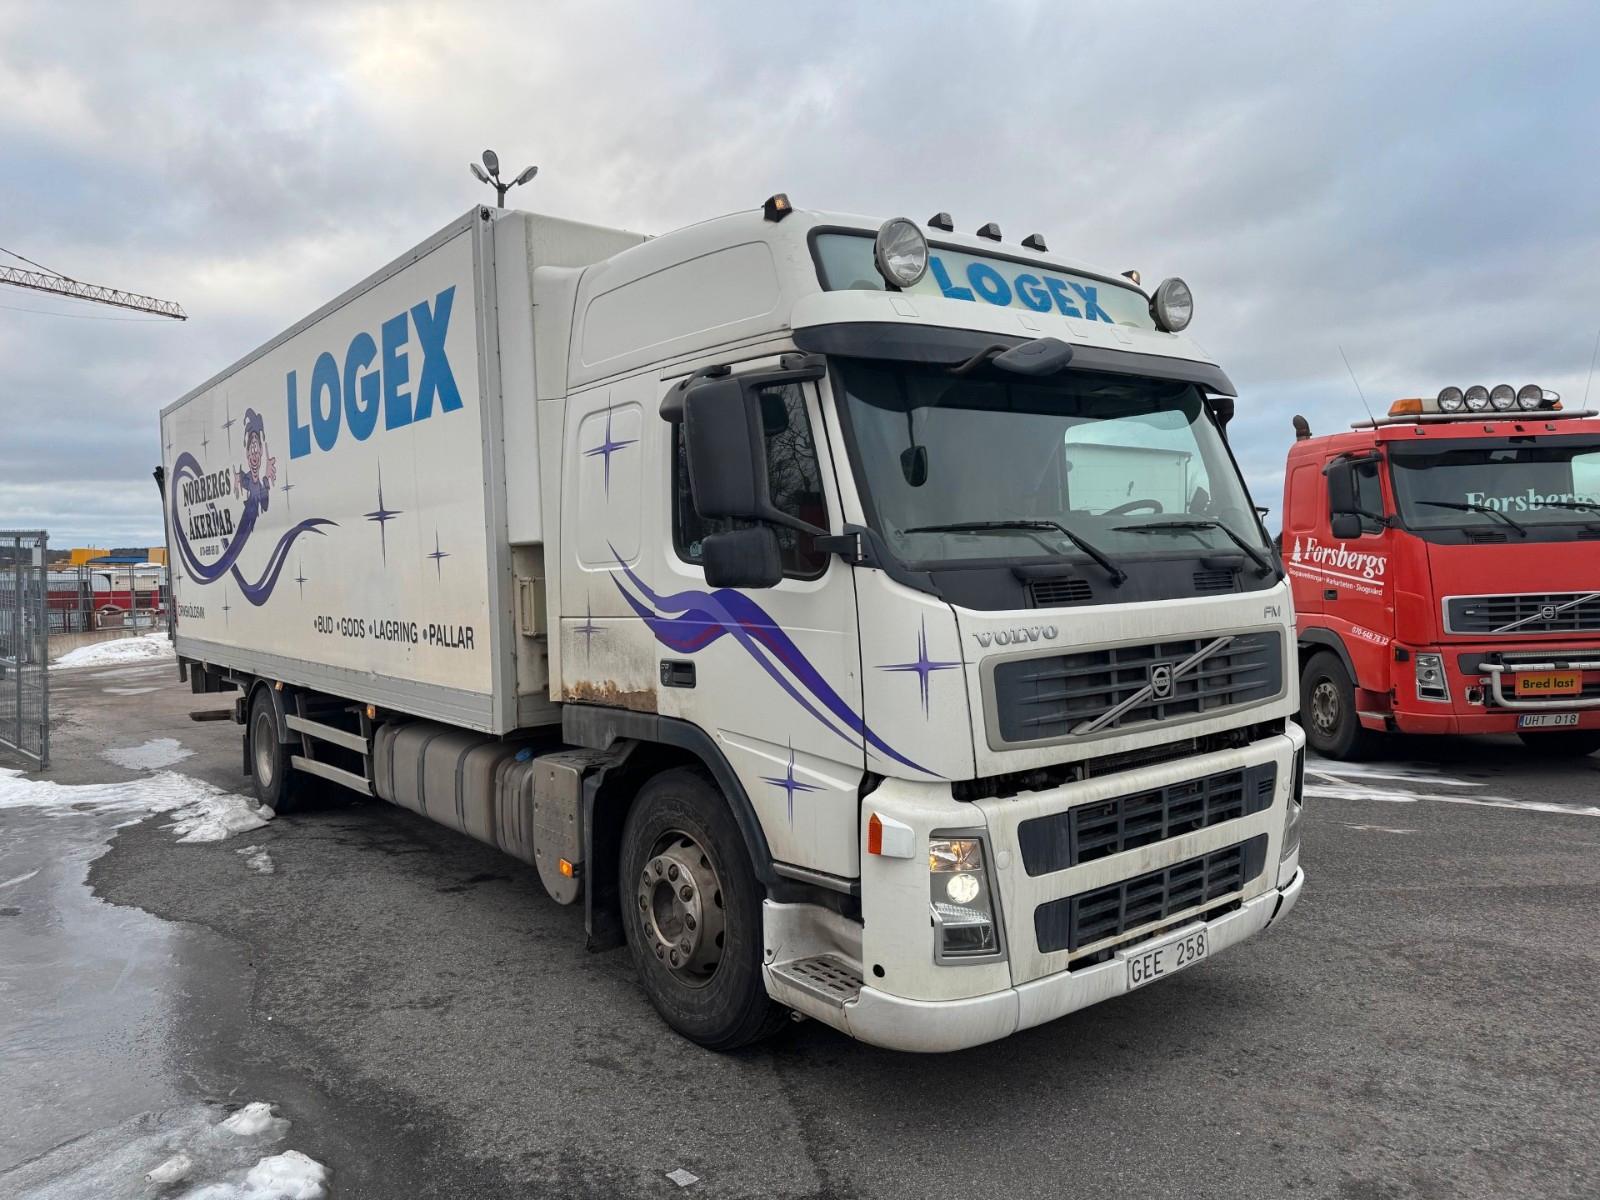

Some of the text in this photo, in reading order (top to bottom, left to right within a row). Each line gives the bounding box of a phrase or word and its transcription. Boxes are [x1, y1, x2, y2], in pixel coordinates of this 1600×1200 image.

[928, 255, 1115, 324] LOGEX
[287, 284, 464, 460] LOGEX
[182, 468, 231, 507] NORBERGS
[1465, 488, 1600, 514] Forsberg
[219, 508, 233, 536] AB
[1304, 537, 1387, 578] Forsbergs
[1263, 605, 1281, 618] FM
[317, 615, 475, 650] BUD GODS LAGRING PALLAR
[970, 624, 1058, 648] VOLVO
[1522, 677, 1575, 689] Bred last
[1524, 714, 1577, 726] UHT 018
[1132, 934, 1205, 983] GEE 258
